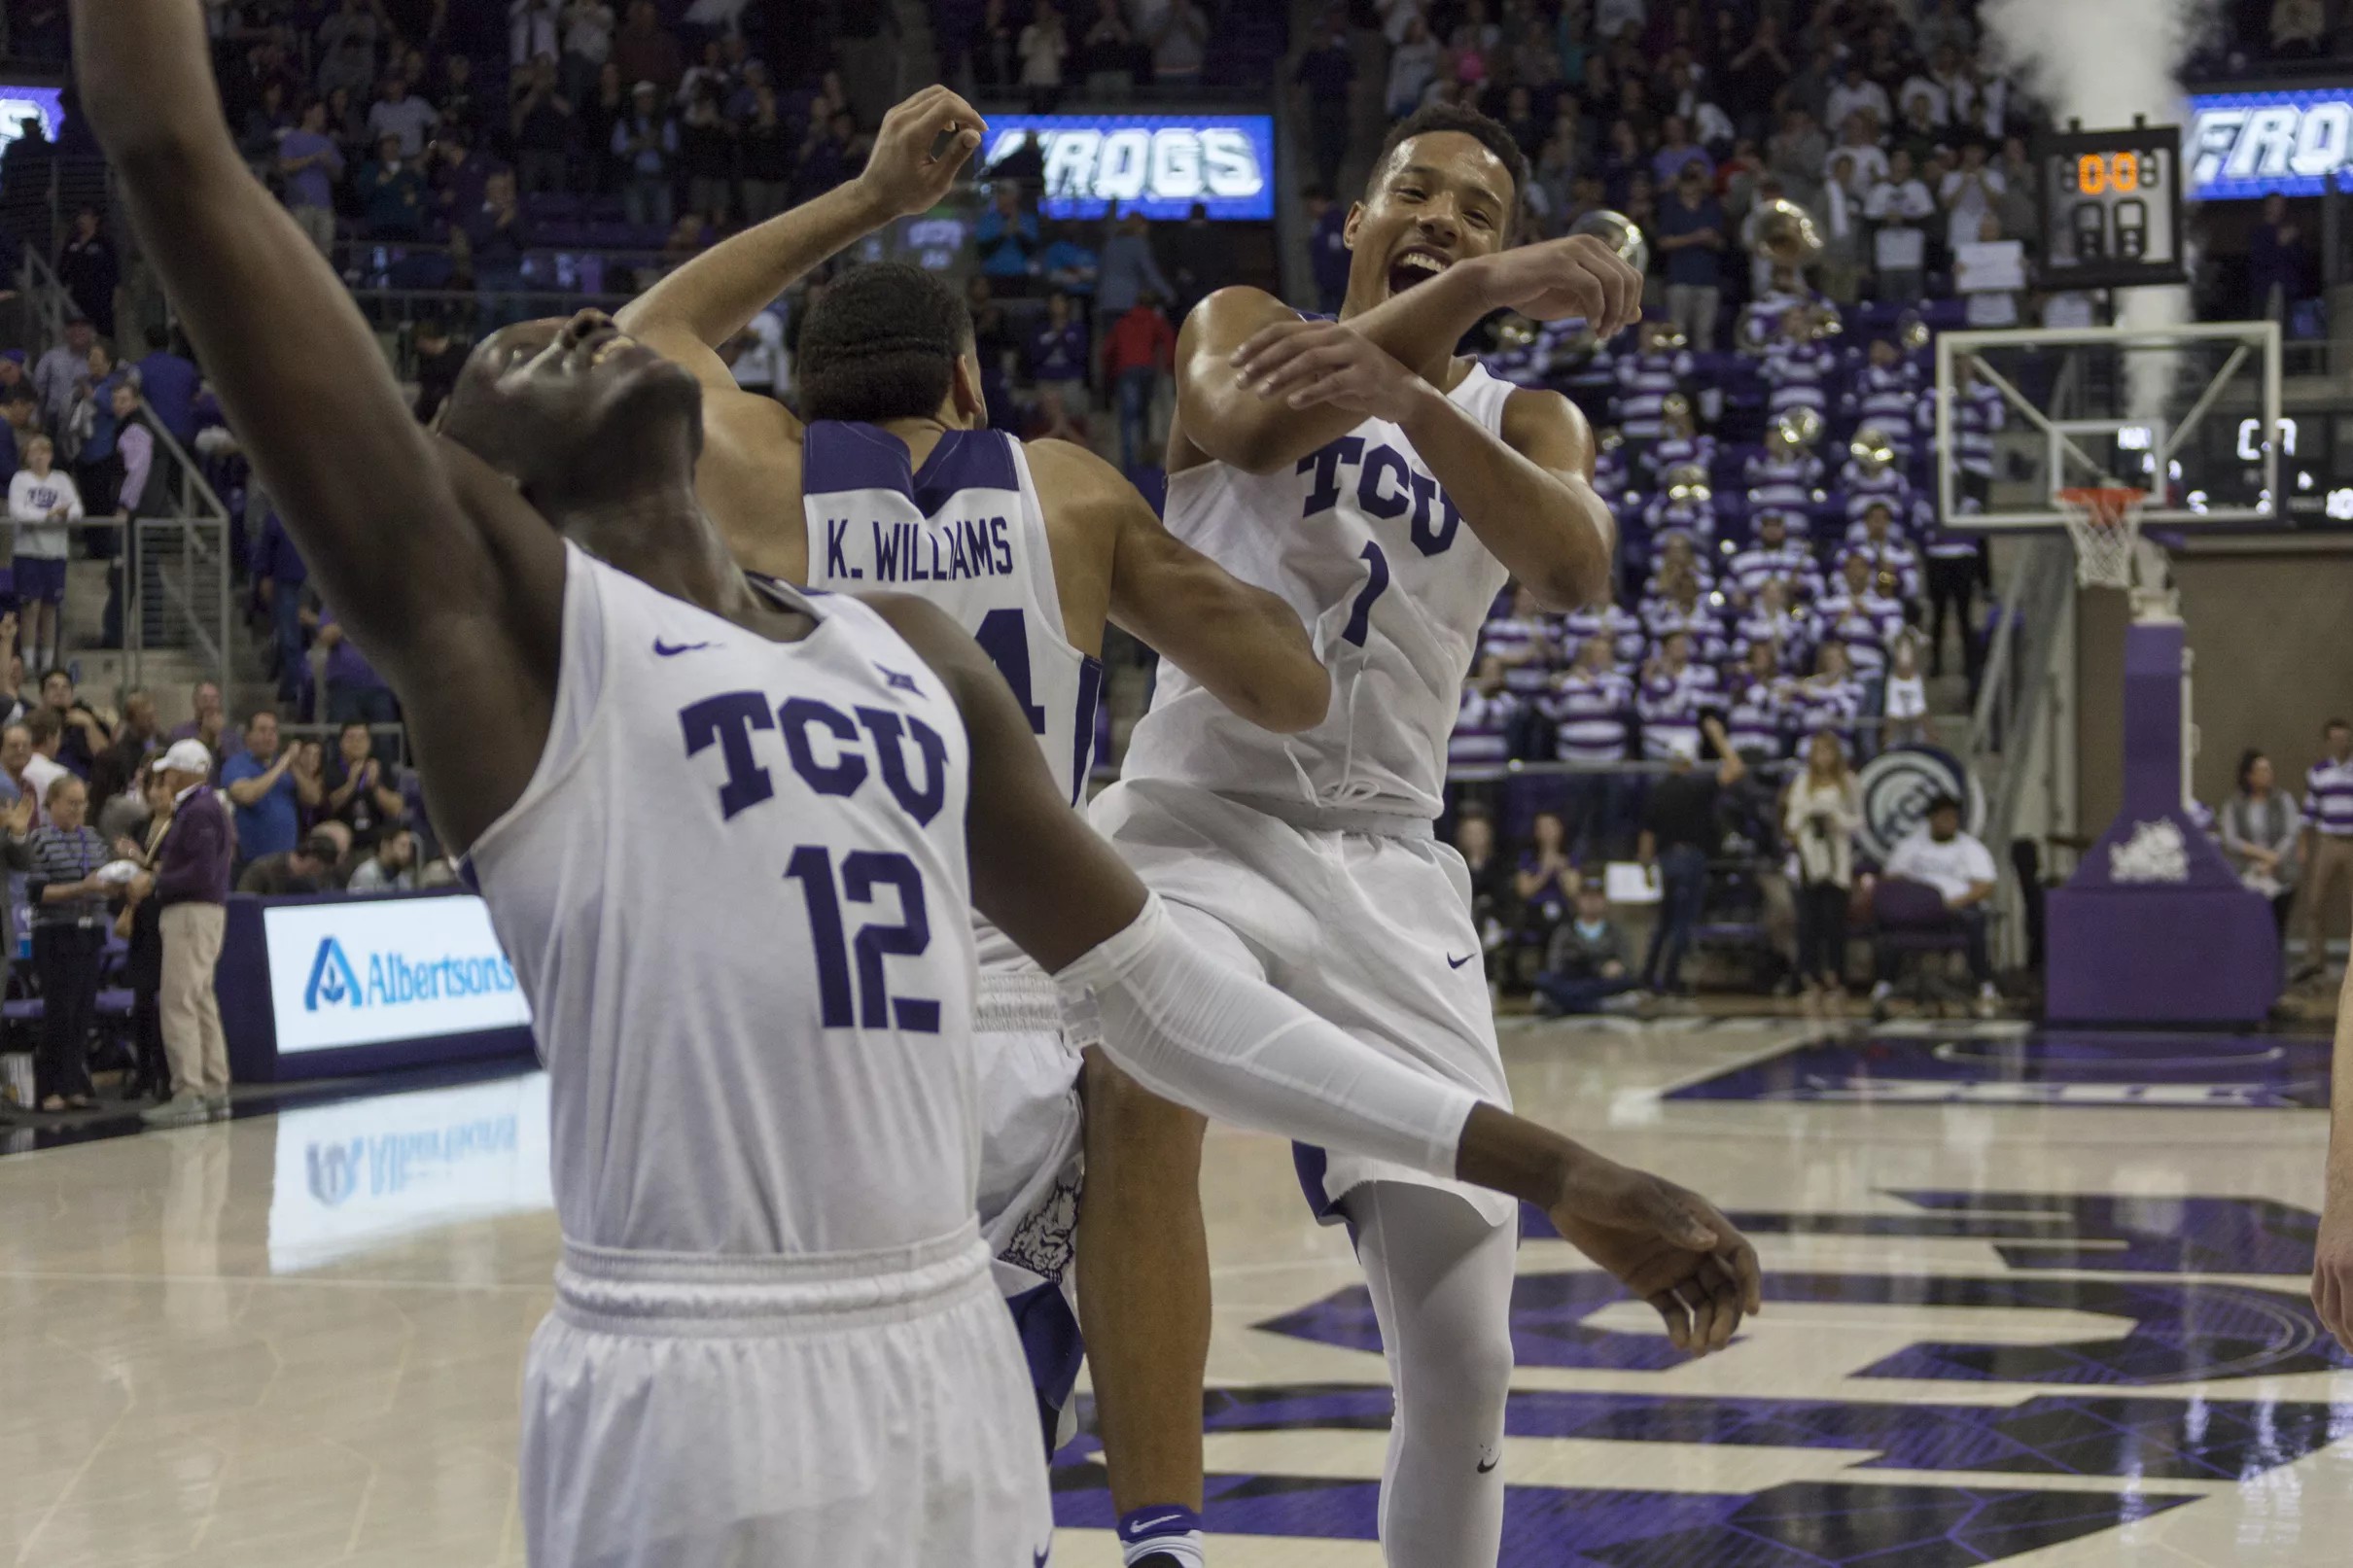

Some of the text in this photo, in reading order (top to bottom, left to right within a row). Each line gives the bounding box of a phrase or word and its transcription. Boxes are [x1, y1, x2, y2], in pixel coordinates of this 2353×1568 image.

[827, 516, 1013, 581] K. WILLIAMS
[1296, 436, 1465, 557] TCU
[1342, 540, 1389, 647] 1
[678, 690, 949, 828] TCU
[366, 952, 515, 1003] Albertsons
[783, 844, 941, 1033] 12
